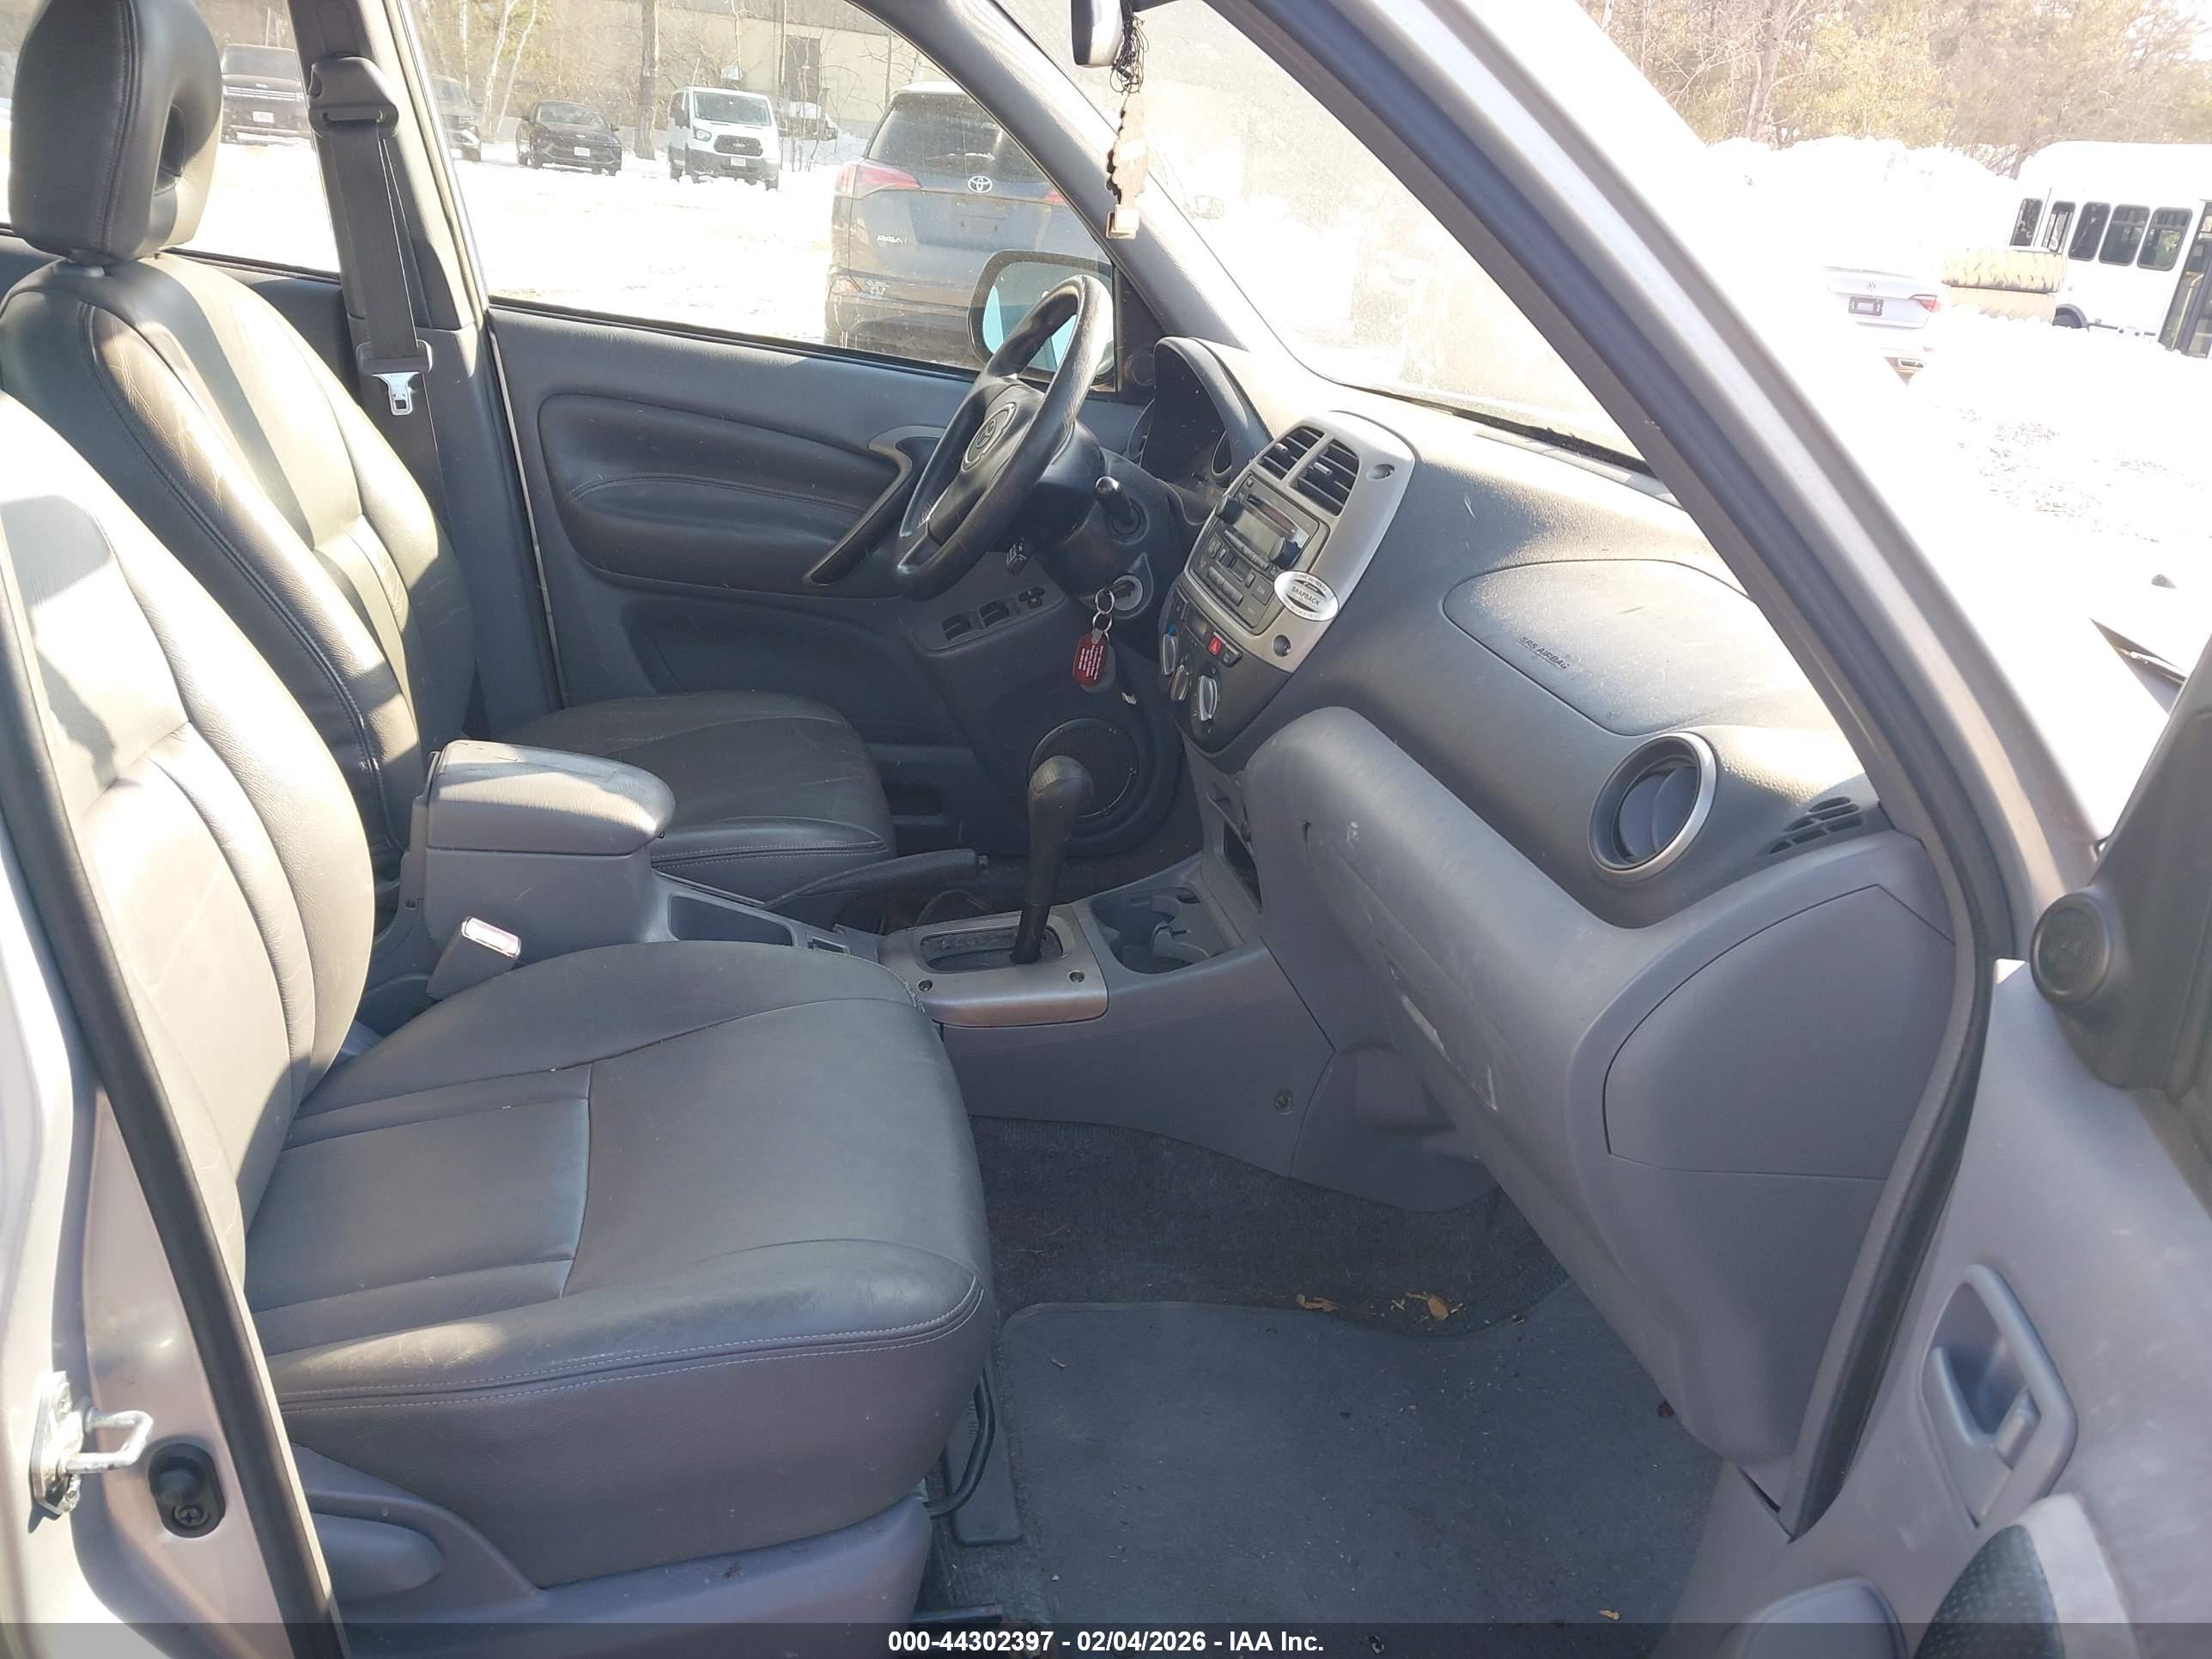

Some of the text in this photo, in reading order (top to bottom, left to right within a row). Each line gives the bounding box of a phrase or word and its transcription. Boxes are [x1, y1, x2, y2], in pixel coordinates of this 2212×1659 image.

[1291, 586, 1321, 605] SNAPBACK
[1520, 637, 1571, 670] SRS AIRBAG
